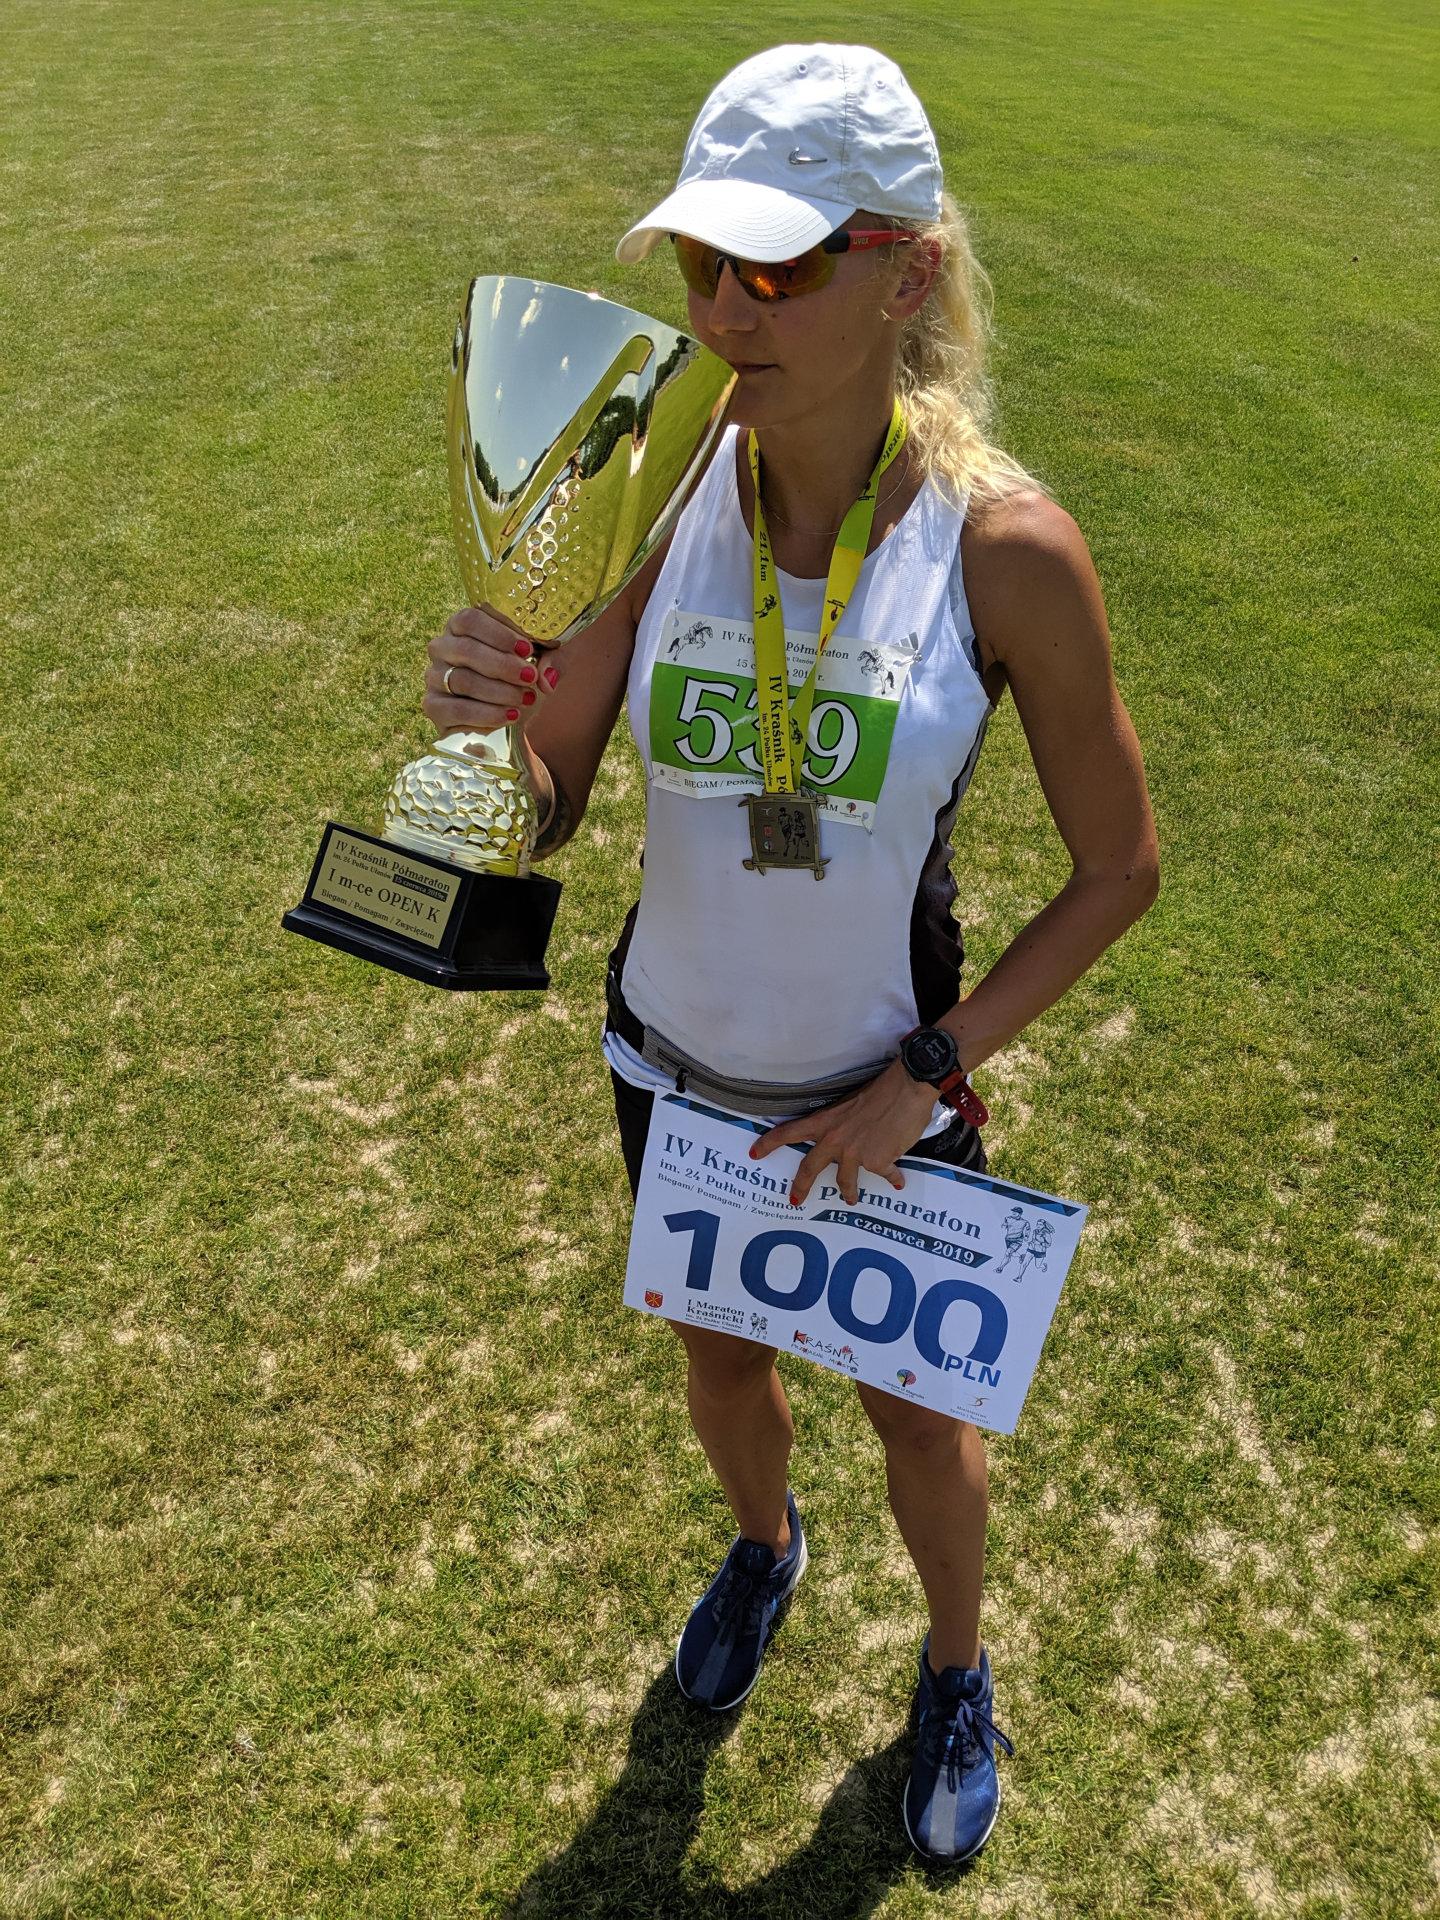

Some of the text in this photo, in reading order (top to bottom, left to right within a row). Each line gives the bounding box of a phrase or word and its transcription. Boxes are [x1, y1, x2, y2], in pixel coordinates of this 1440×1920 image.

[722, 631, 734, 640] IV
[736, 658, 748, 668] 15
[792, 669, 808, 678] 201
[769, 676, 782, 692] IV
[770, 700, 786, 763] Kraśnik
[684, 778, 718, 788] BIEGAM
[336, 840, 450, 892] IV Kraśnik Półmaraton
[328, 868, 441, 924] I m-ce OPEN K
[321, 888, 348, 904] Biegam
[354, 902, 388, 922] Pomagam
[395, 918, 434, 940] Zwyciężam
[659, 1158, 680, 1174] im.
[684, 1168, 700, 1182] 24
[706, 1174, 746, 1198] Pułku
[664, 1132, 694, 1158] IV
[701, 1146, 796, 1196] Kraśni
[697, 1187, 742, 1209] Pomagam
[750, 1206, 804, 1220] Zwyciężam
[826, 1210, 975, 1264] 15 czerwca 2019
[662, 1209, 1009, 1370] 1000
[686, 1306, 744, 1324] Kraśnicki
[696, 1300, 745, 1316] Maraton
[793, 1329, 859, 1366] KRAŚNIK
[944, 1354, 1001, 1388] PLN
